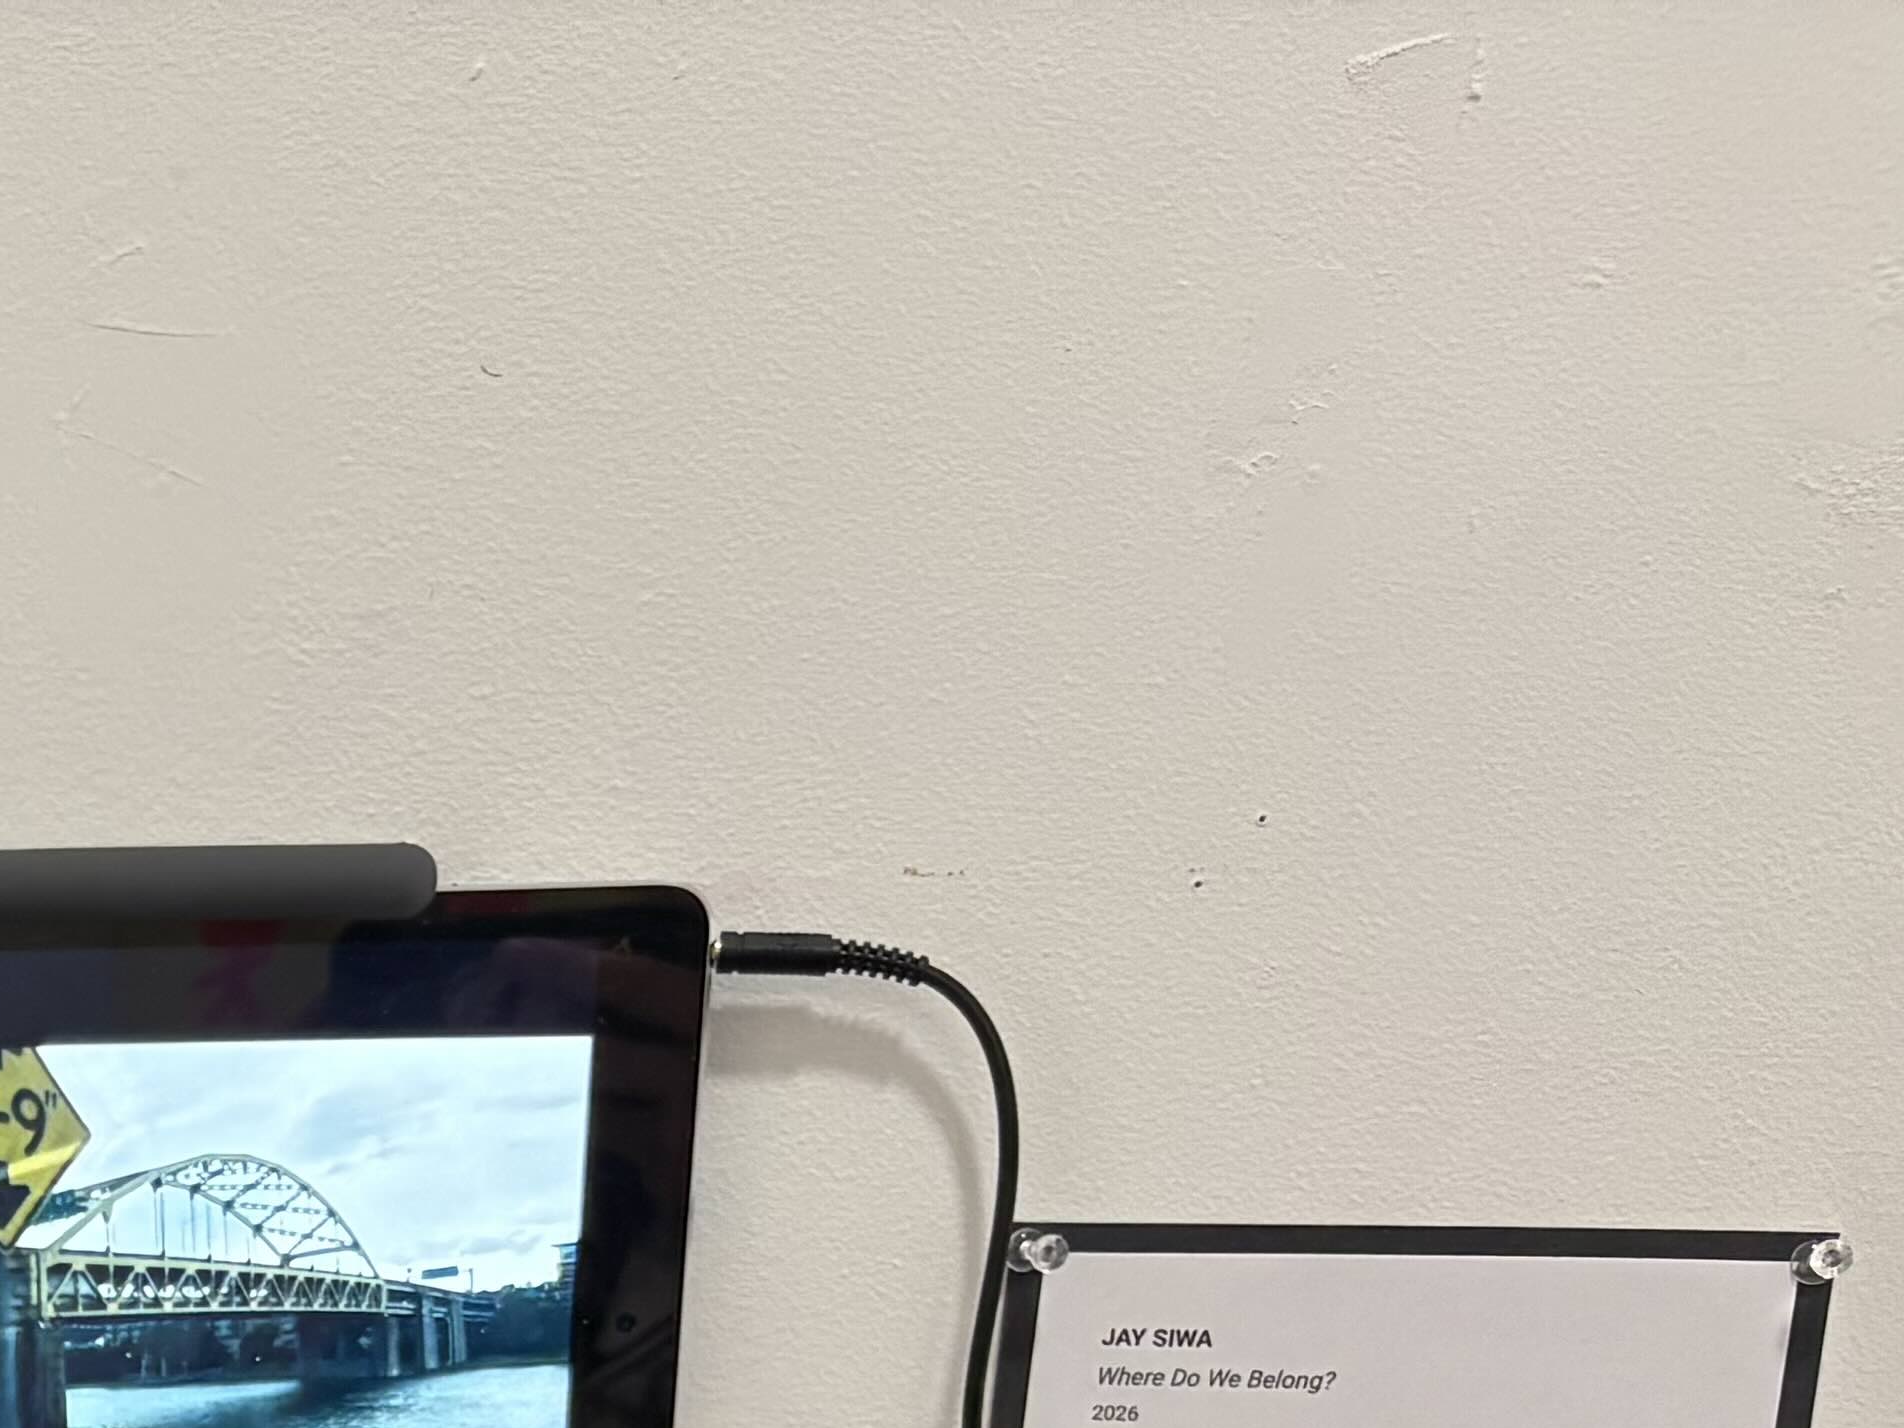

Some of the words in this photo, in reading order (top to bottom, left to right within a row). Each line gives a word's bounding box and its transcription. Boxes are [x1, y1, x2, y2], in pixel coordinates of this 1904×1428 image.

[1101, 1327, 1148, 1347] JAY
[1151, 1328, 1213, 1349] SIWA
[1098, 1365, 1166, 1387] Where
[1170, 1367, 1201, 1388] Do
[1209, 1368, 1242, 1389] We
[1246, 1369, 1337, 1395] Belong?
[1091, 1404, 1140, 1423] 2026
